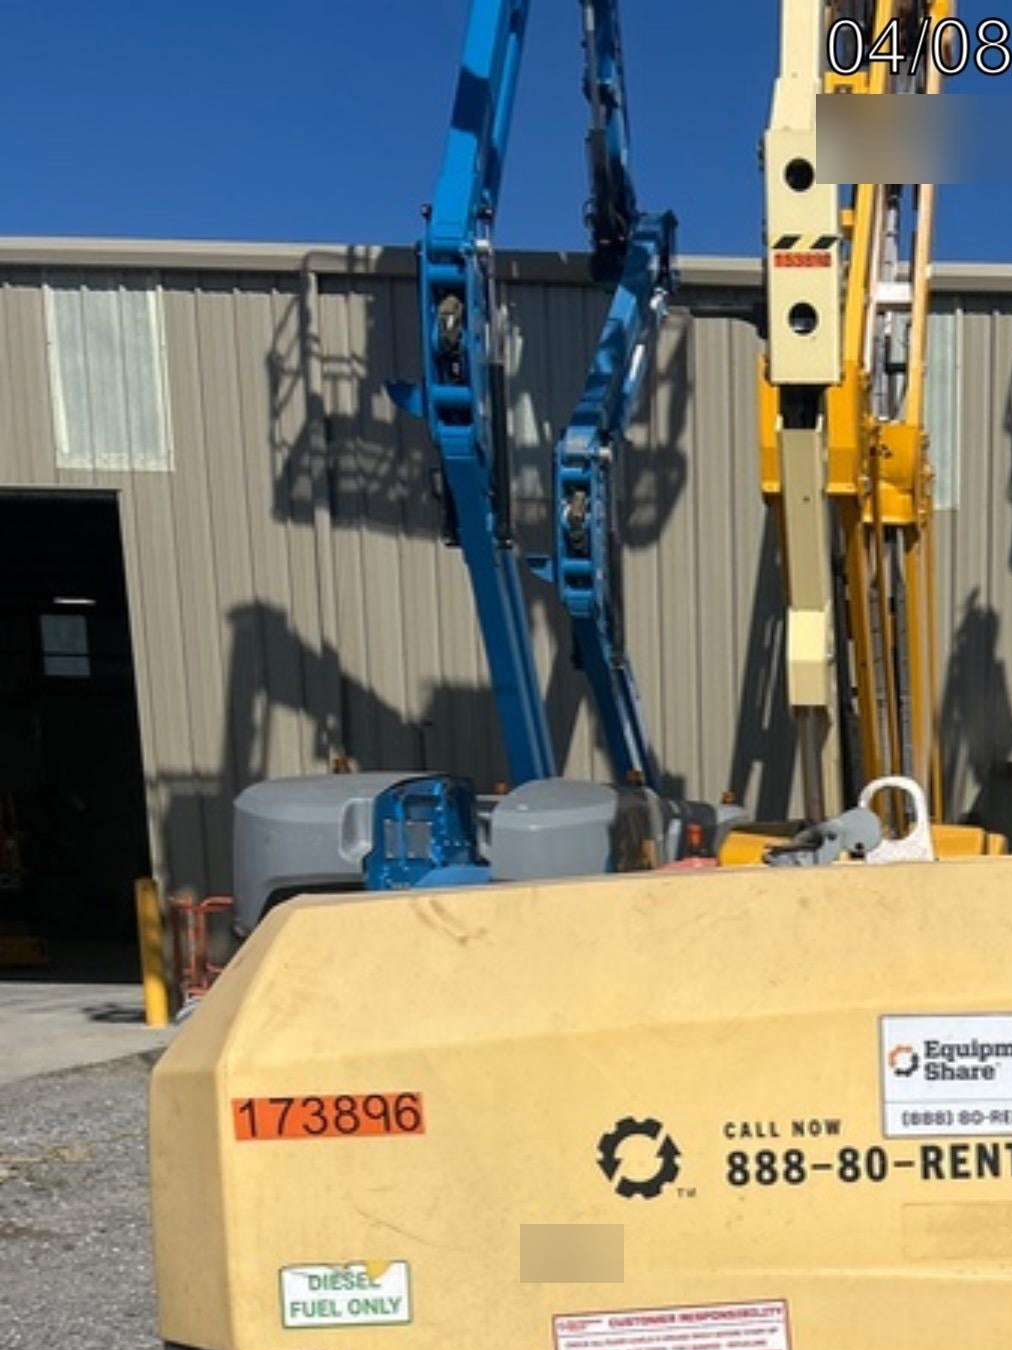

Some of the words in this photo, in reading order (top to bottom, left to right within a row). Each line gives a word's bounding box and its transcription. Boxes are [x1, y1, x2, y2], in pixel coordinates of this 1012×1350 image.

[924, 1062, 996, 1081] Share
[239, 1092, 421, 1138] 173896
[903, 1110, 953, 1127] (888)
[724, 1121, 781, 1140] CALL
[791, 1119, 842, 1138] NOW
[289, 1300, 342, 1319] FUEL
[347, 1296, 402, 1316] ONLY
